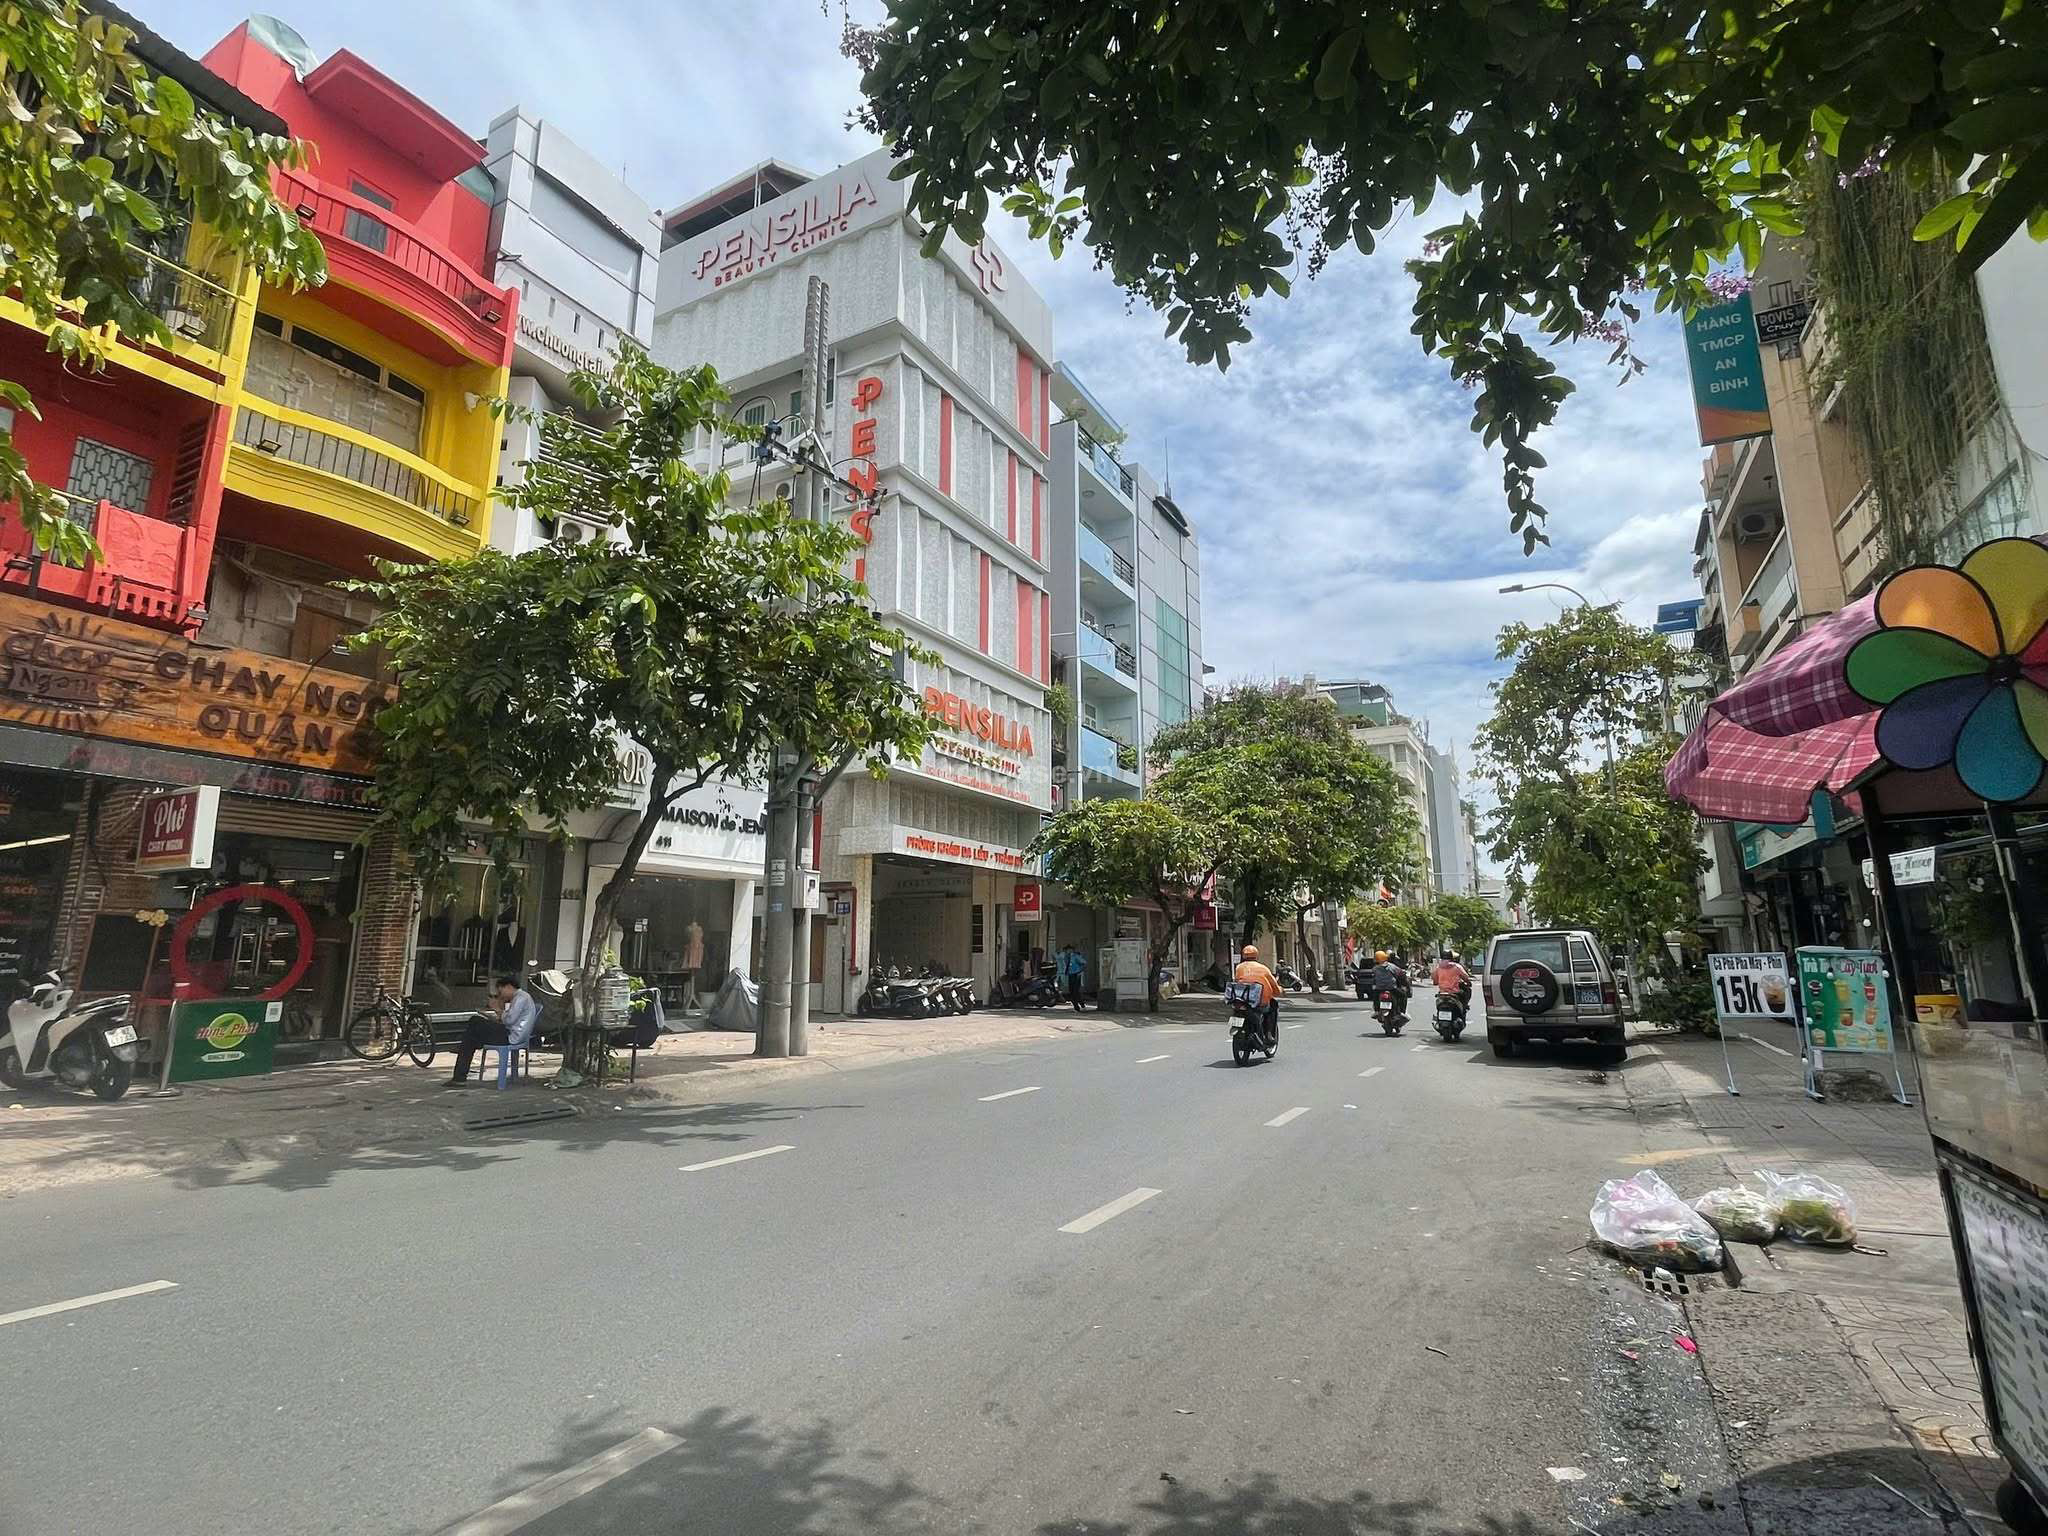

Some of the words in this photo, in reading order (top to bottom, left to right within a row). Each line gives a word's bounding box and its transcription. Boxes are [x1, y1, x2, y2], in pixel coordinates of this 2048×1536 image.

[692, 172, 877, 280] PENSILIA
[714, 251, 777, 287] BEAUTY
[790, 220, 849, 254] CLINIC
[1696, 313, 1742, 332] HÀNG
[1759, 308, 1794, 328] BOVIS
[1699, 334, 1745, 352] TMCP
[1714, 357, 1737, 371] AN
[1710, 376, 1749, 393] BÌNH
[154, 651, 286, 700] CHAY
[924, 686, 1034, 757] PENSILIA
[153, 795, 188, 838] Phở
[661, 806, 719, 829] MAISON
[720, 815, 737, 832] de
[1717, 974, 1763, 1014] 15k
